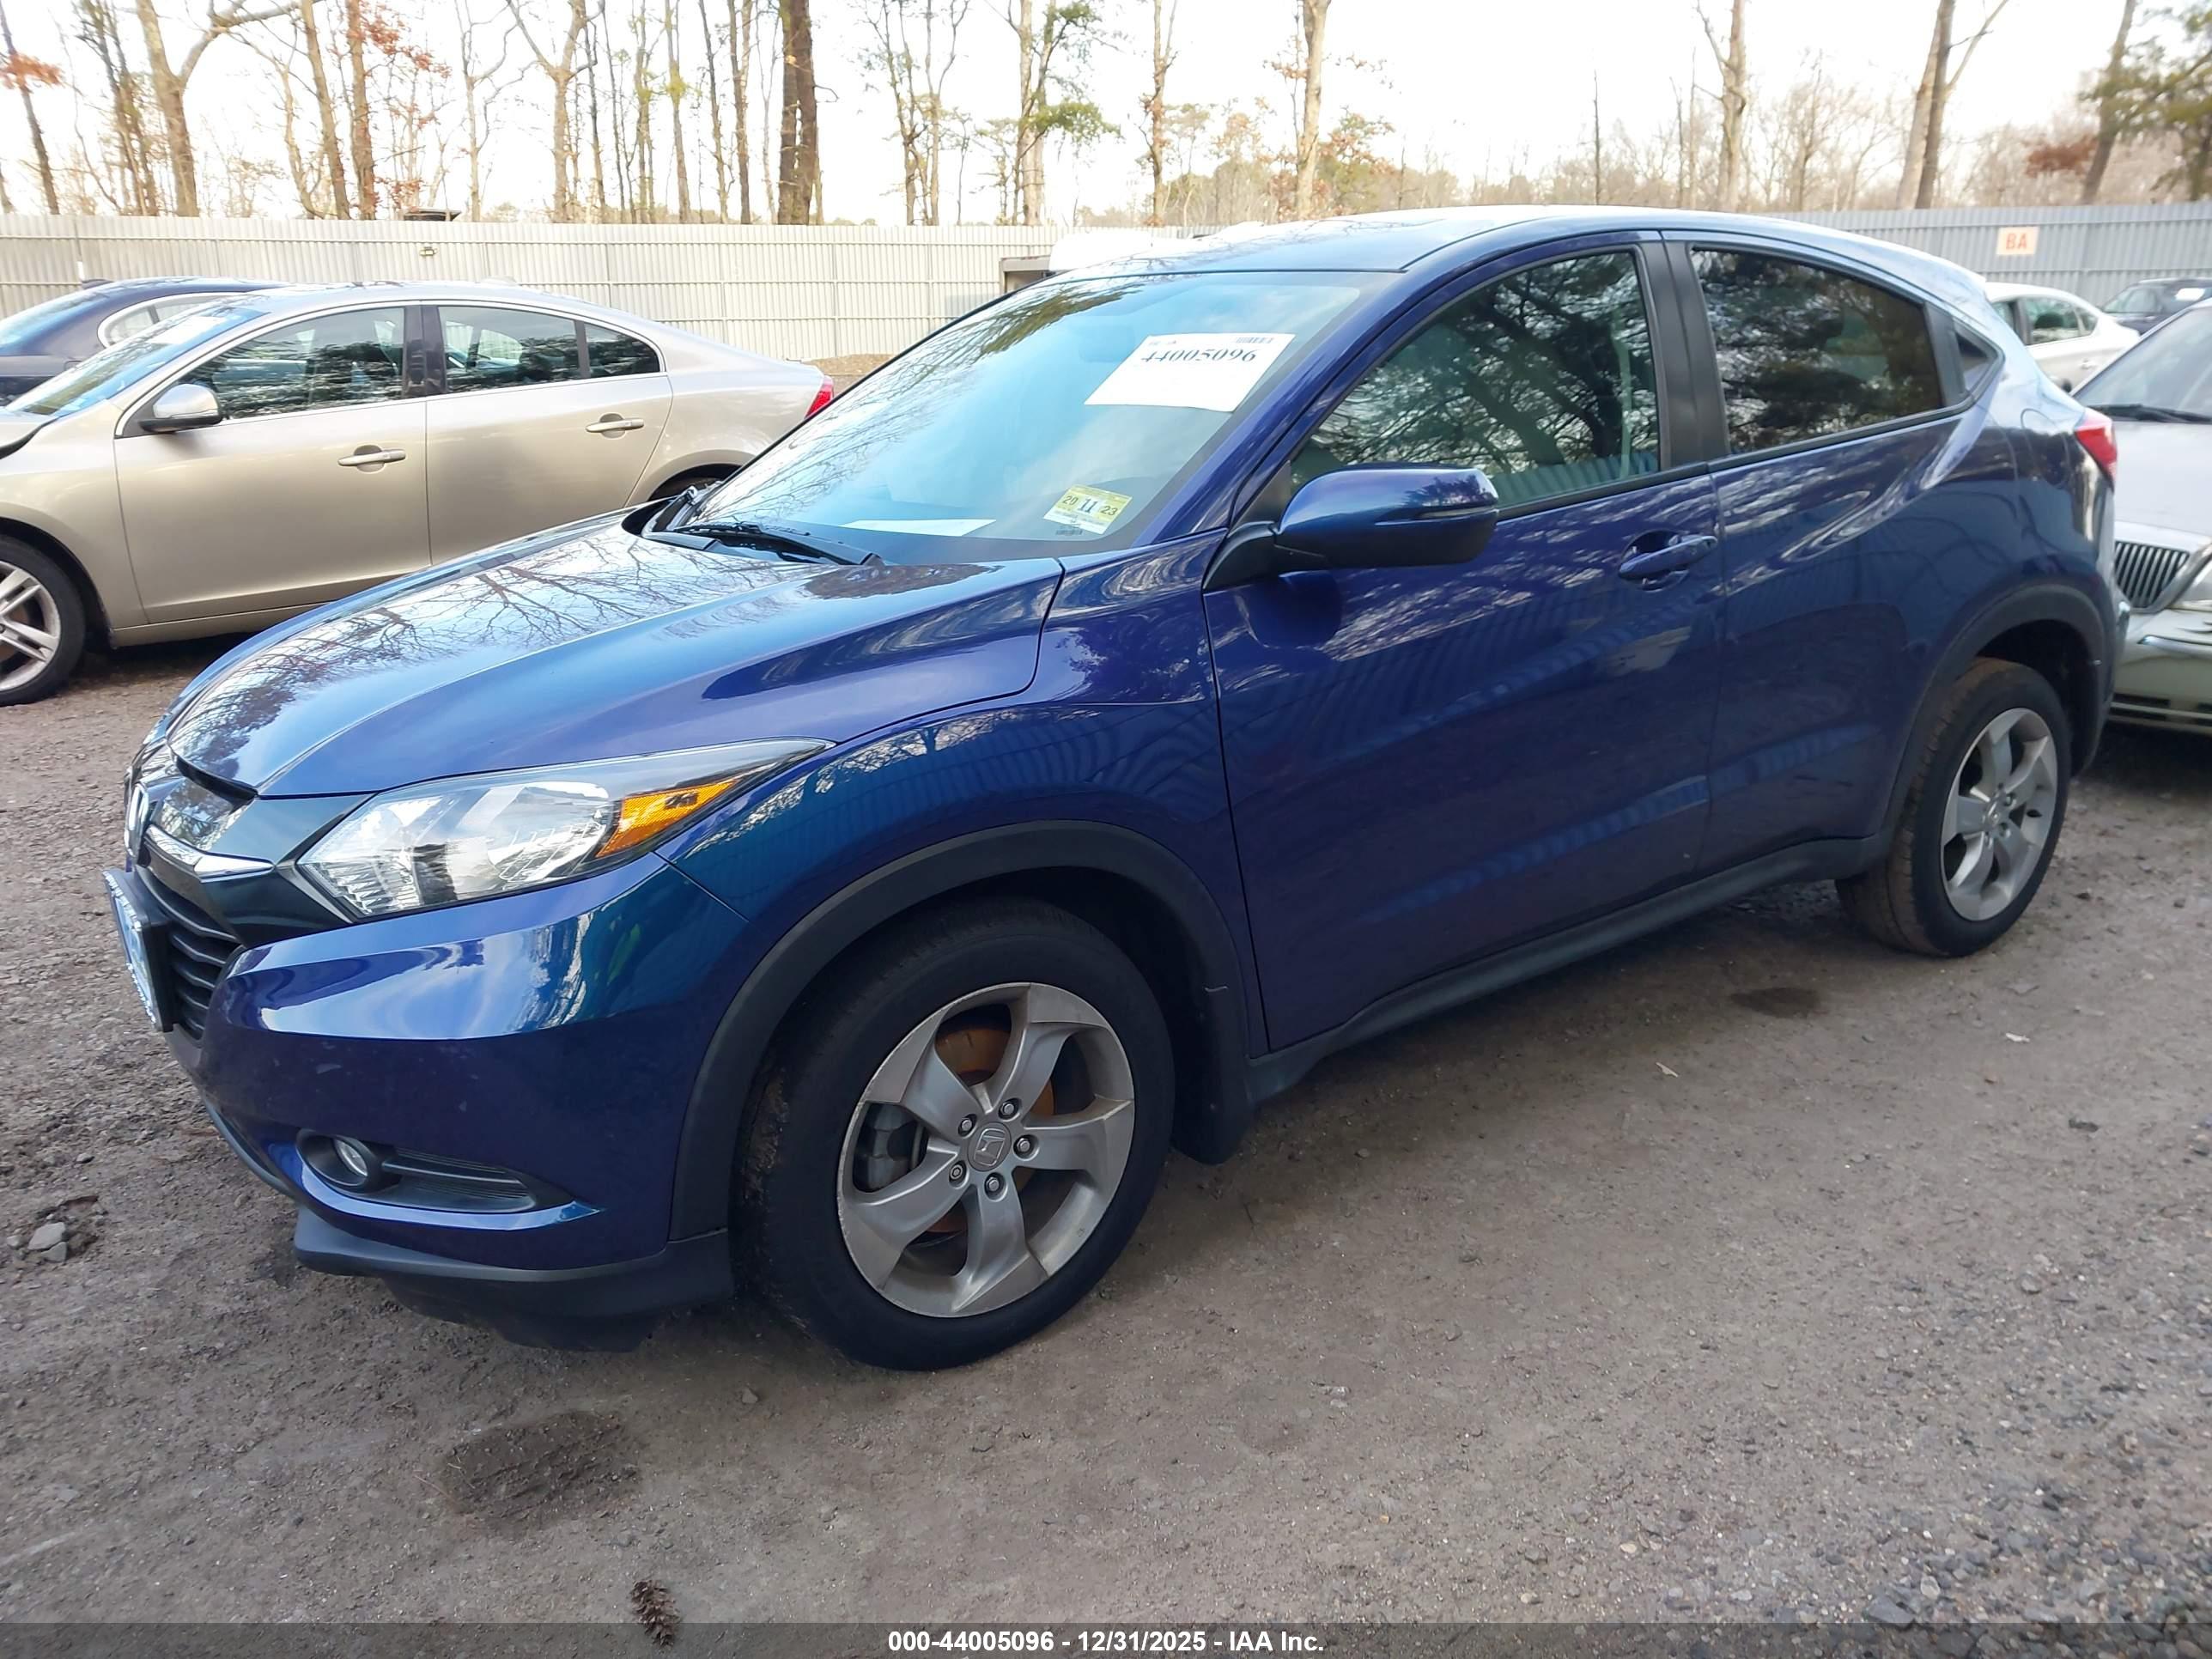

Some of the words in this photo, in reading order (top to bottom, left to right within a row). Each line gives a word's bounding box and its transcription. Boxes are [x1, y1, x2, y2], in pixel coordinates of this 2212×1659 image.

[2006, 233, 2027, 249] BA
[1141, 349, 1260, 362] 44005096
[1062, 495, 1079, 506] 20
[1078, 498, 1097, 514] 11
[1101, 505, 1118, 515] 23
